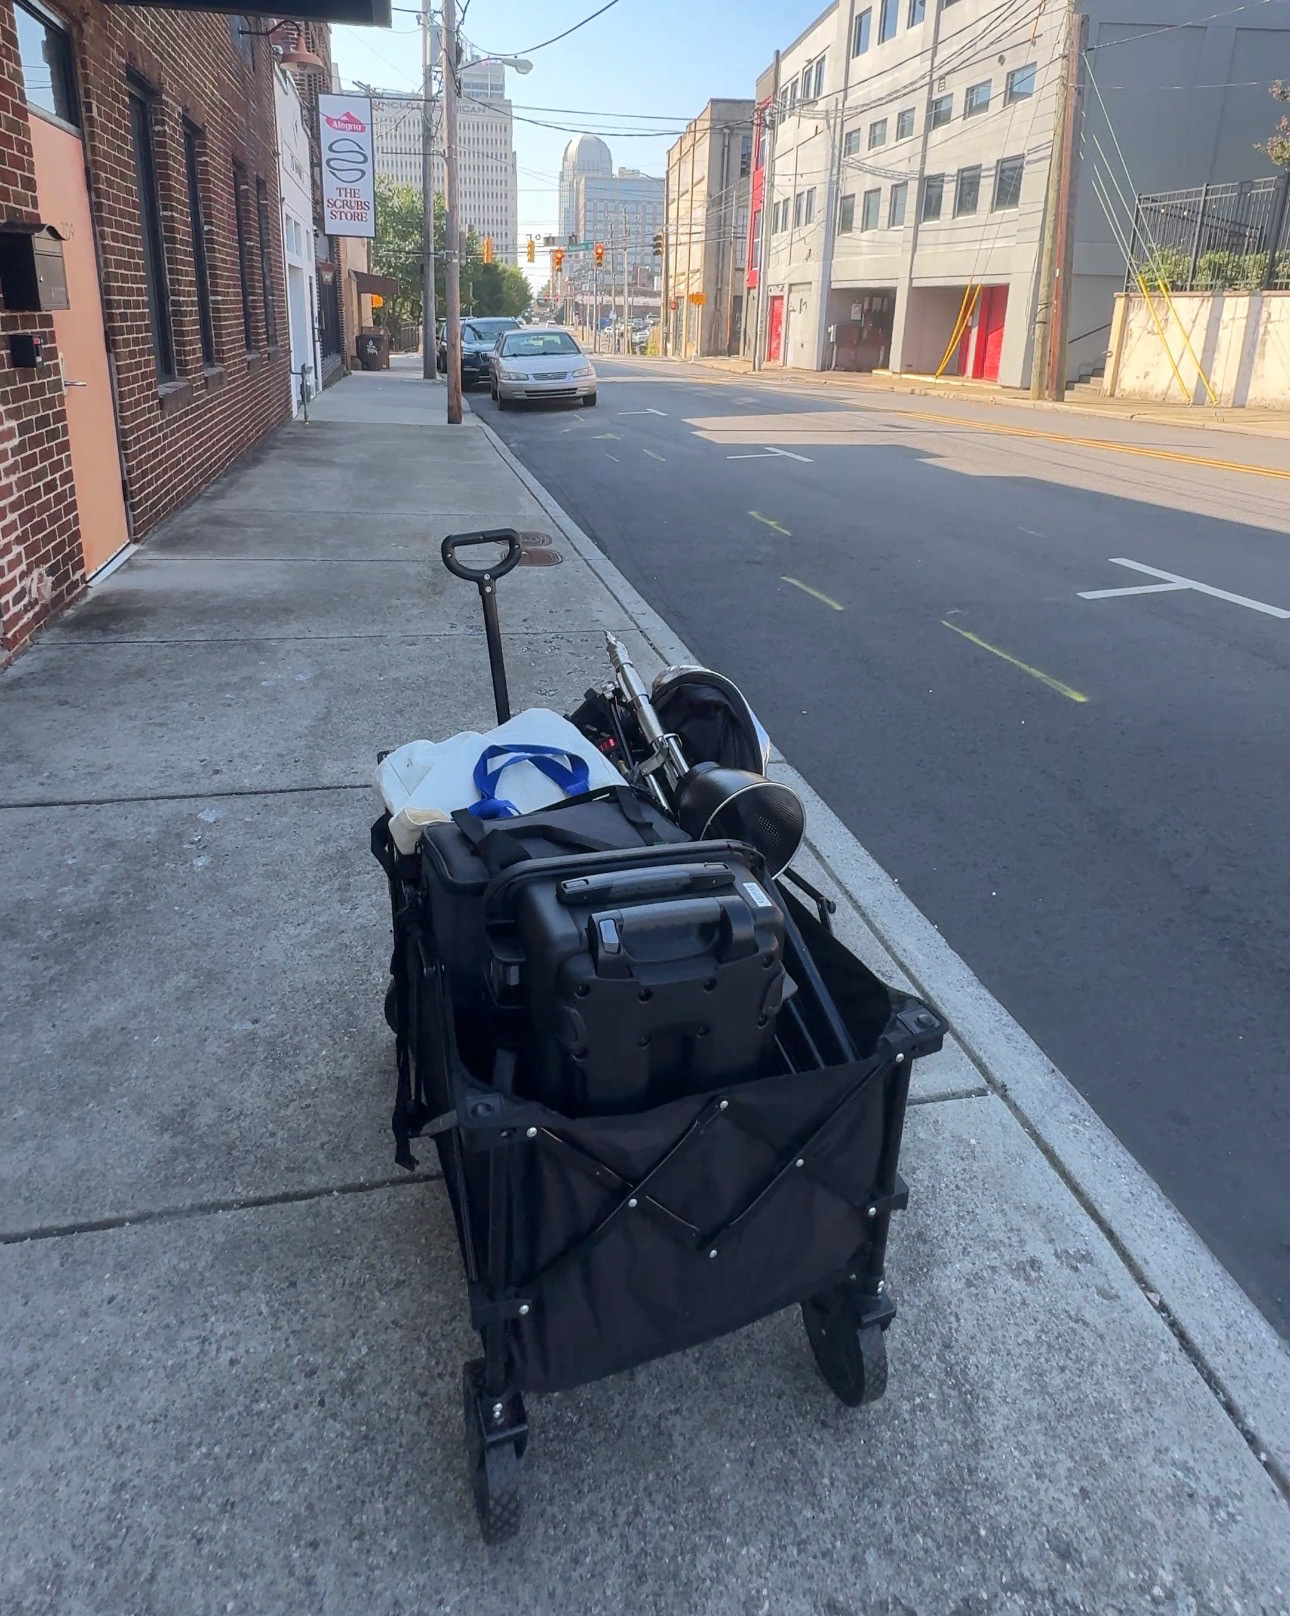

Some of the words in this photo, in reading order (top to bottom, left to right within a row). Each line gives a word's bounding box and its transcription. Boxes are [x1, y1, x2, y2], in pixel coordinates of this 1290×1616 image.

[331, 120, 362, 131] Alegria
[335, 187, 361, 199] THE
[326, 198, 371, 211] SCRUBS
[330, 210, 369, 222] STORE
